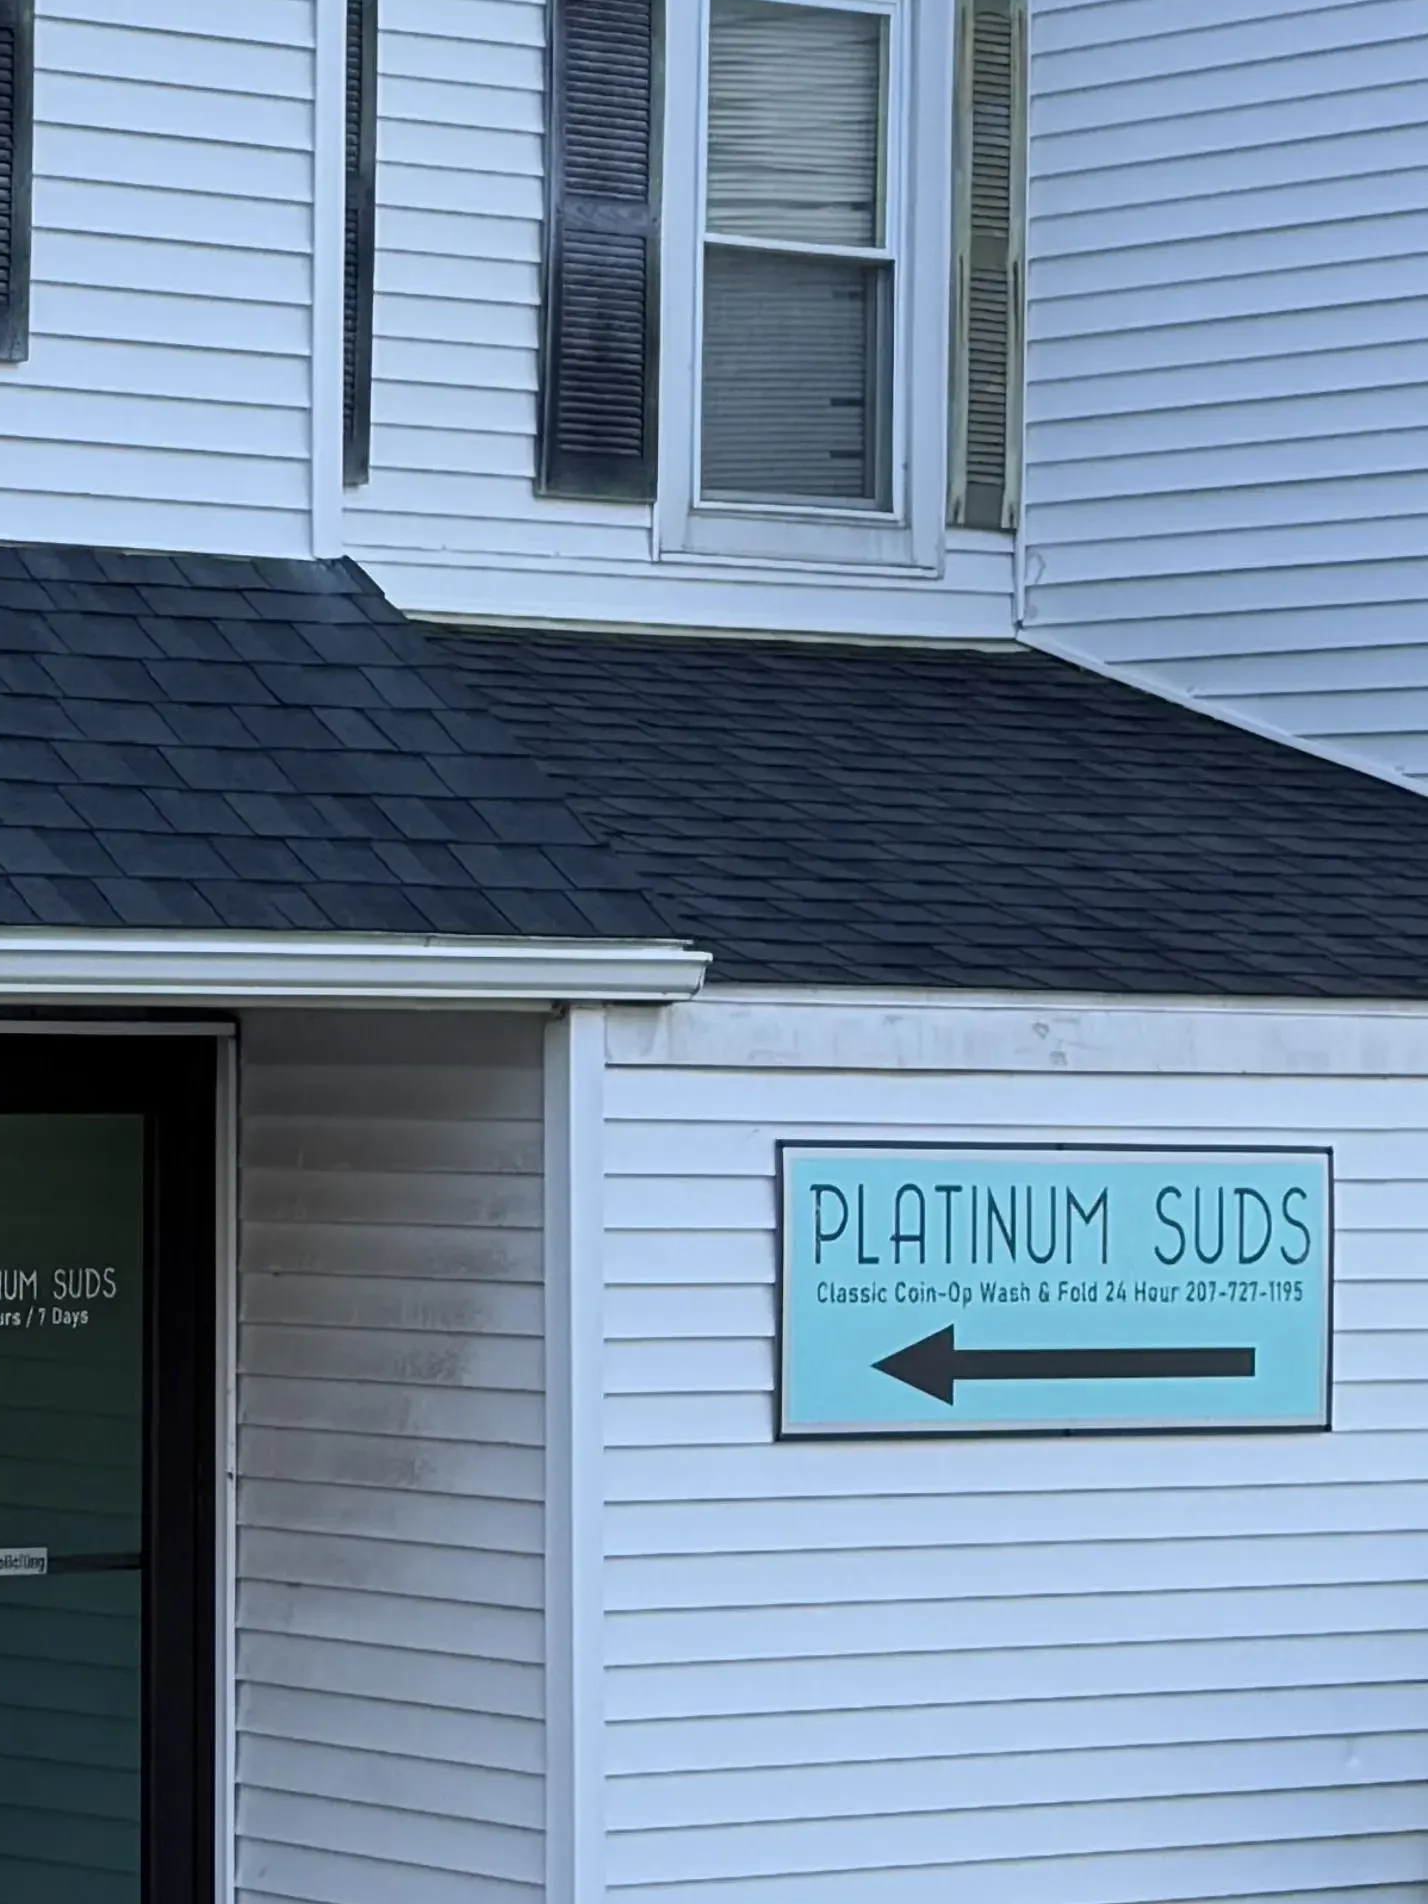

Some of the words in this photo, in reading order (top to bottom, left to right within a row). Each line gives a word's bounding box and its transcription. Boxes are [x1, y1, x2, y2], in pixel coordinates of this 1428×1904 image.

[810, 1183, 1109, 1265] PLATINUM
[1154, 1186, 1311, 1266] SUDS
[53, 1267, 117, 1300] SUDS
[817, 1281, 887, 1304] Classic
[895, 1281, 973, 1309] Coin-Op
[980, 1281, 1031, 1304] Wash
[1038, 1282, 1050, 1304] &
[1057, 1281, 1098, 1304] Fold
[1106, 1282, 1127, 1303] 24
[1135, 1281, 1178, 1303] Hour
[1185, 1281, 1303, 1302] 207-727-1195
[39, 1308, 46, 1325] 7
[52, 1307, 88, 1328] Days
